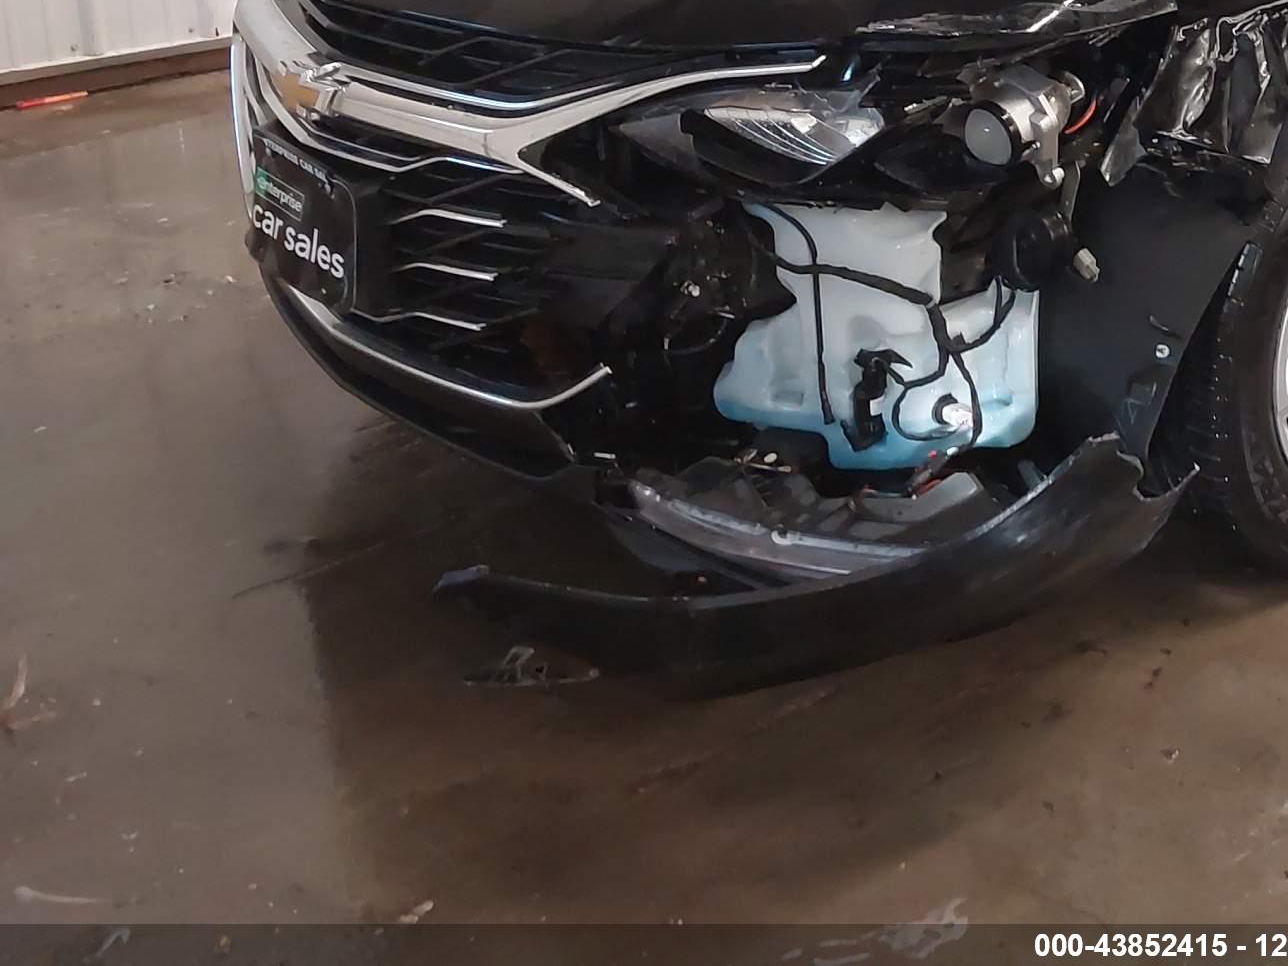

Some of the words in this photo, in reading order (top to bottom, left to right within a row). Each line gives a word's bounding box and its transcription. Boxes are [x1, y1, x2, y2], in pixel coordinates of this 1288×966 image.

[256, 176, 302, 212] enterprise
[252, 203, 284, 240] car
[283, 228, 345, 279] sales
